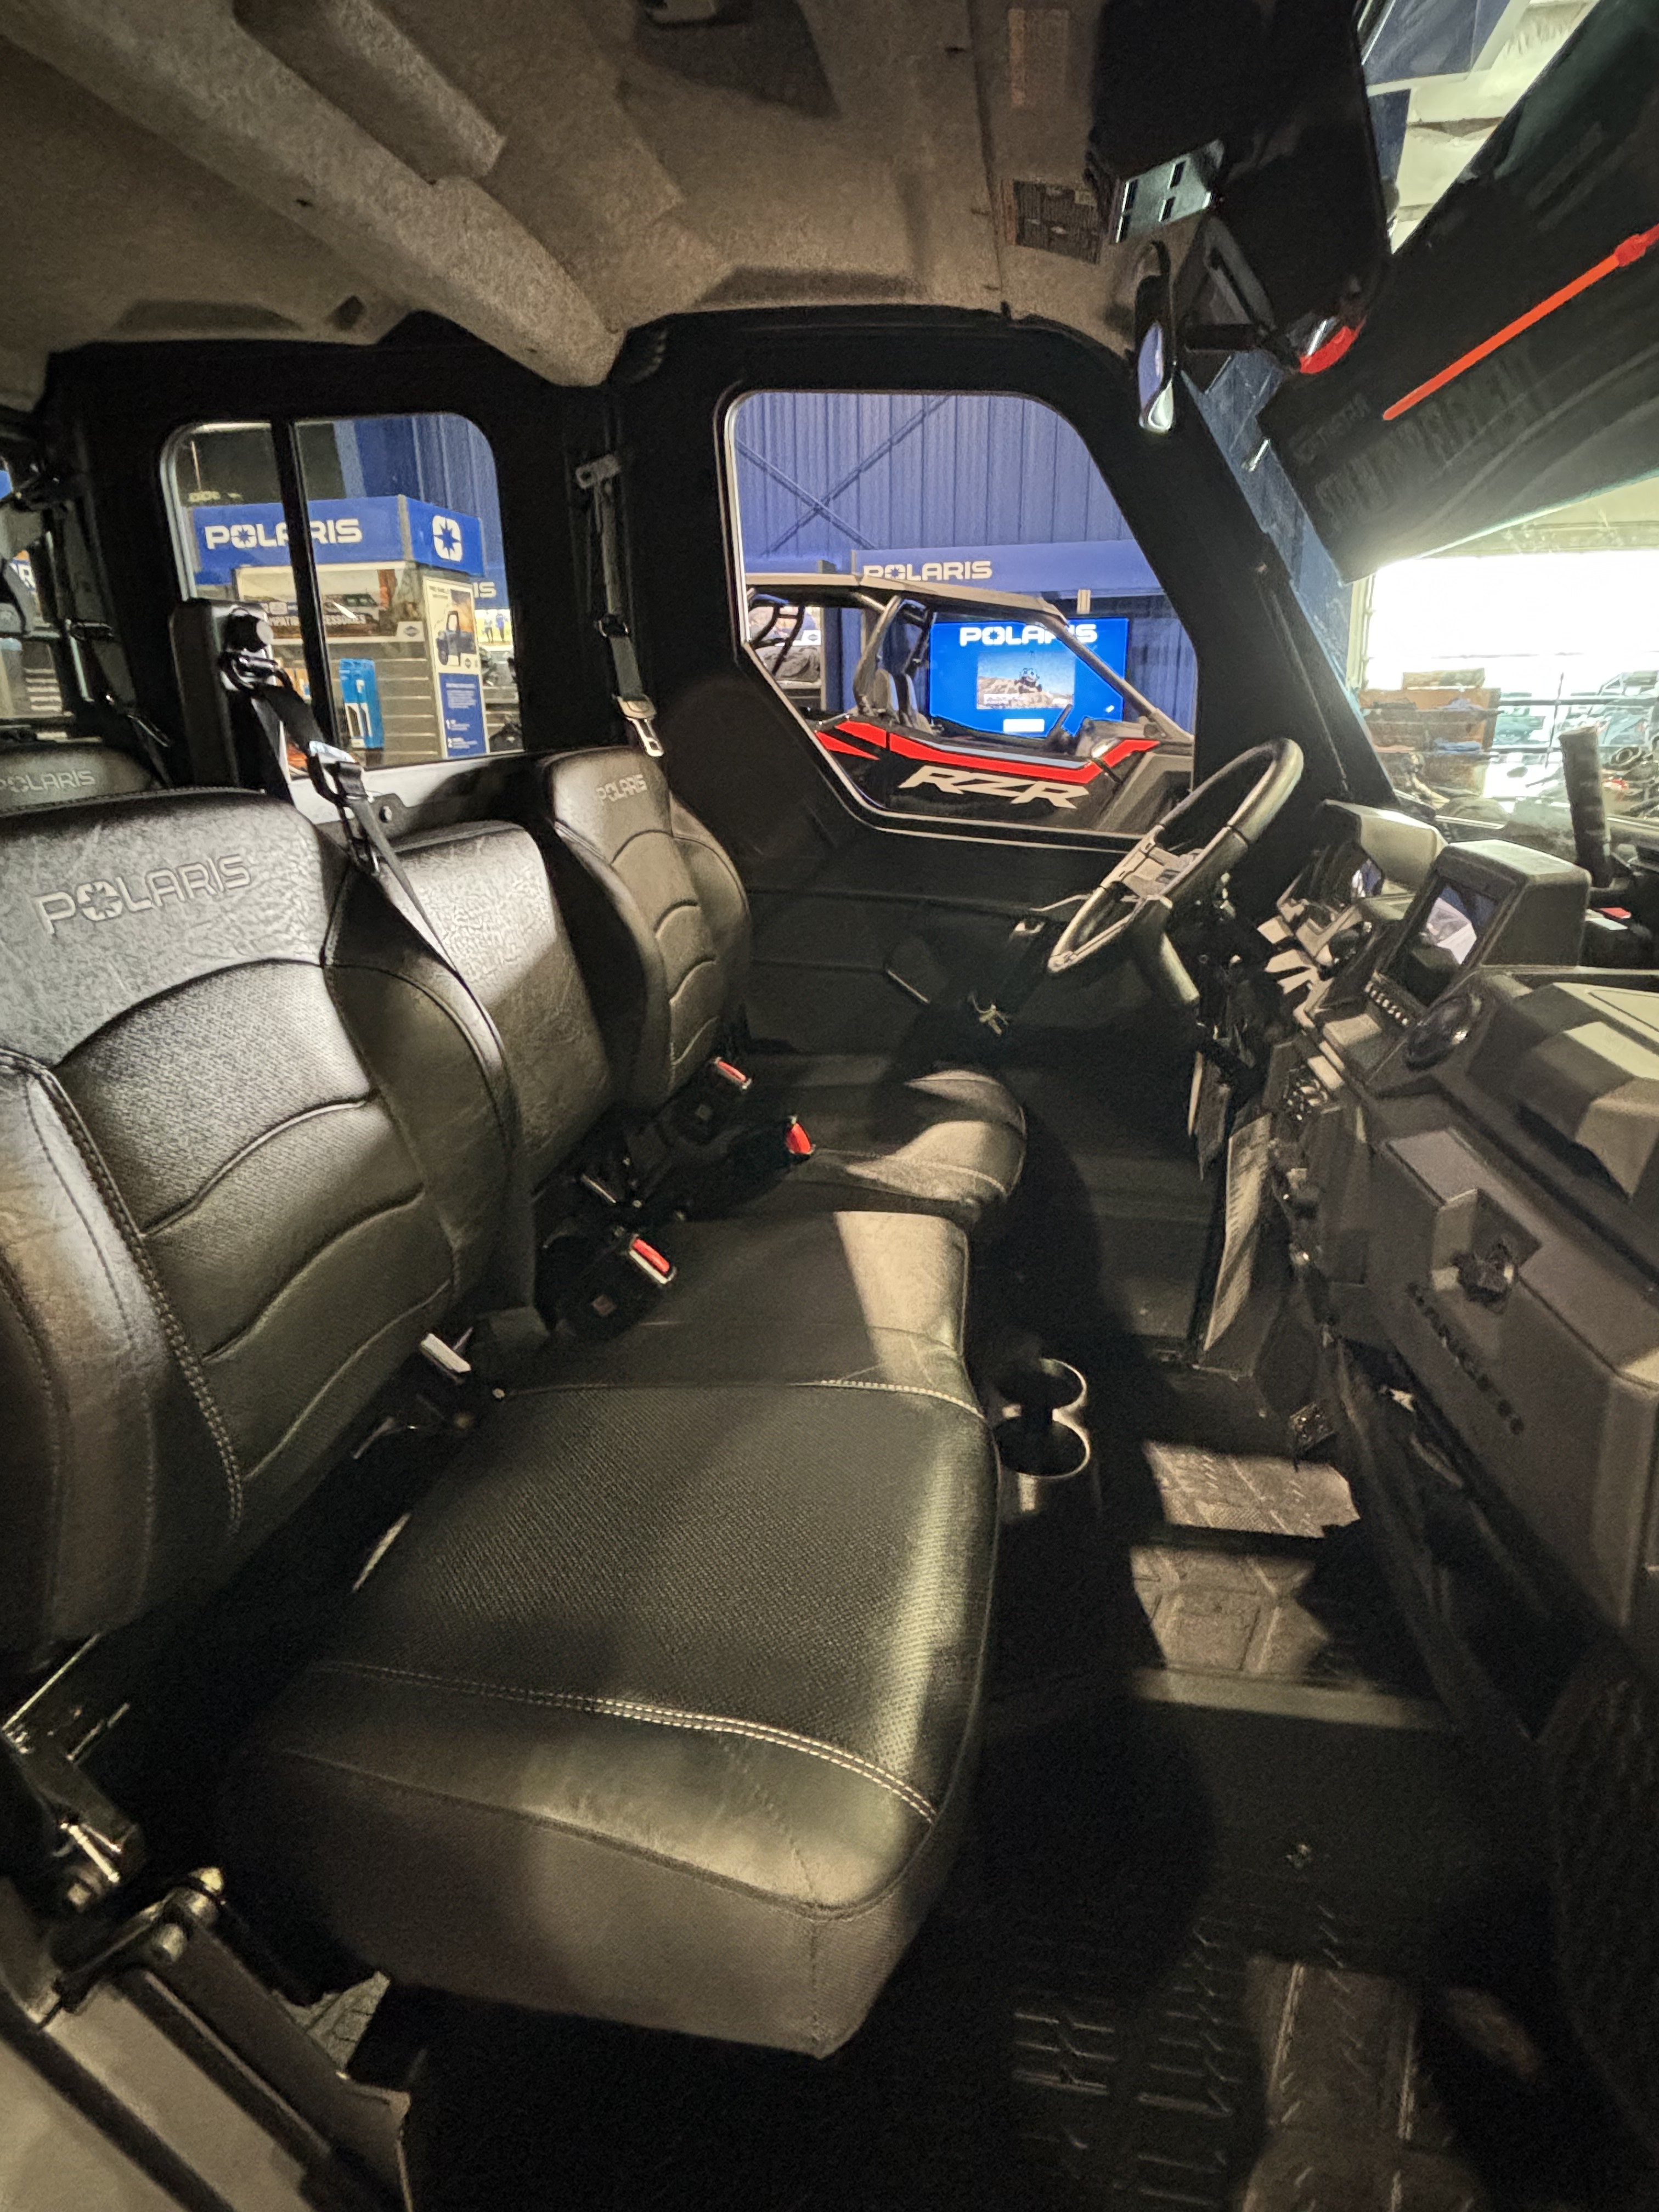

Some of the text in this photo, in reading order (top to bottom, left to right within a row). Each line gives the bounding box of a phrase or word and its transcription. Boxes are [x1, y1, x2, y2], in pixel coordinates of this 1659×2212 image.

[863, 561, 992, 580] POLARIS
[595, 773, 647, 806] POLARIS
[899, 765, 1090, 809] RZR
[32, 854, 251, 934] POLARIS
